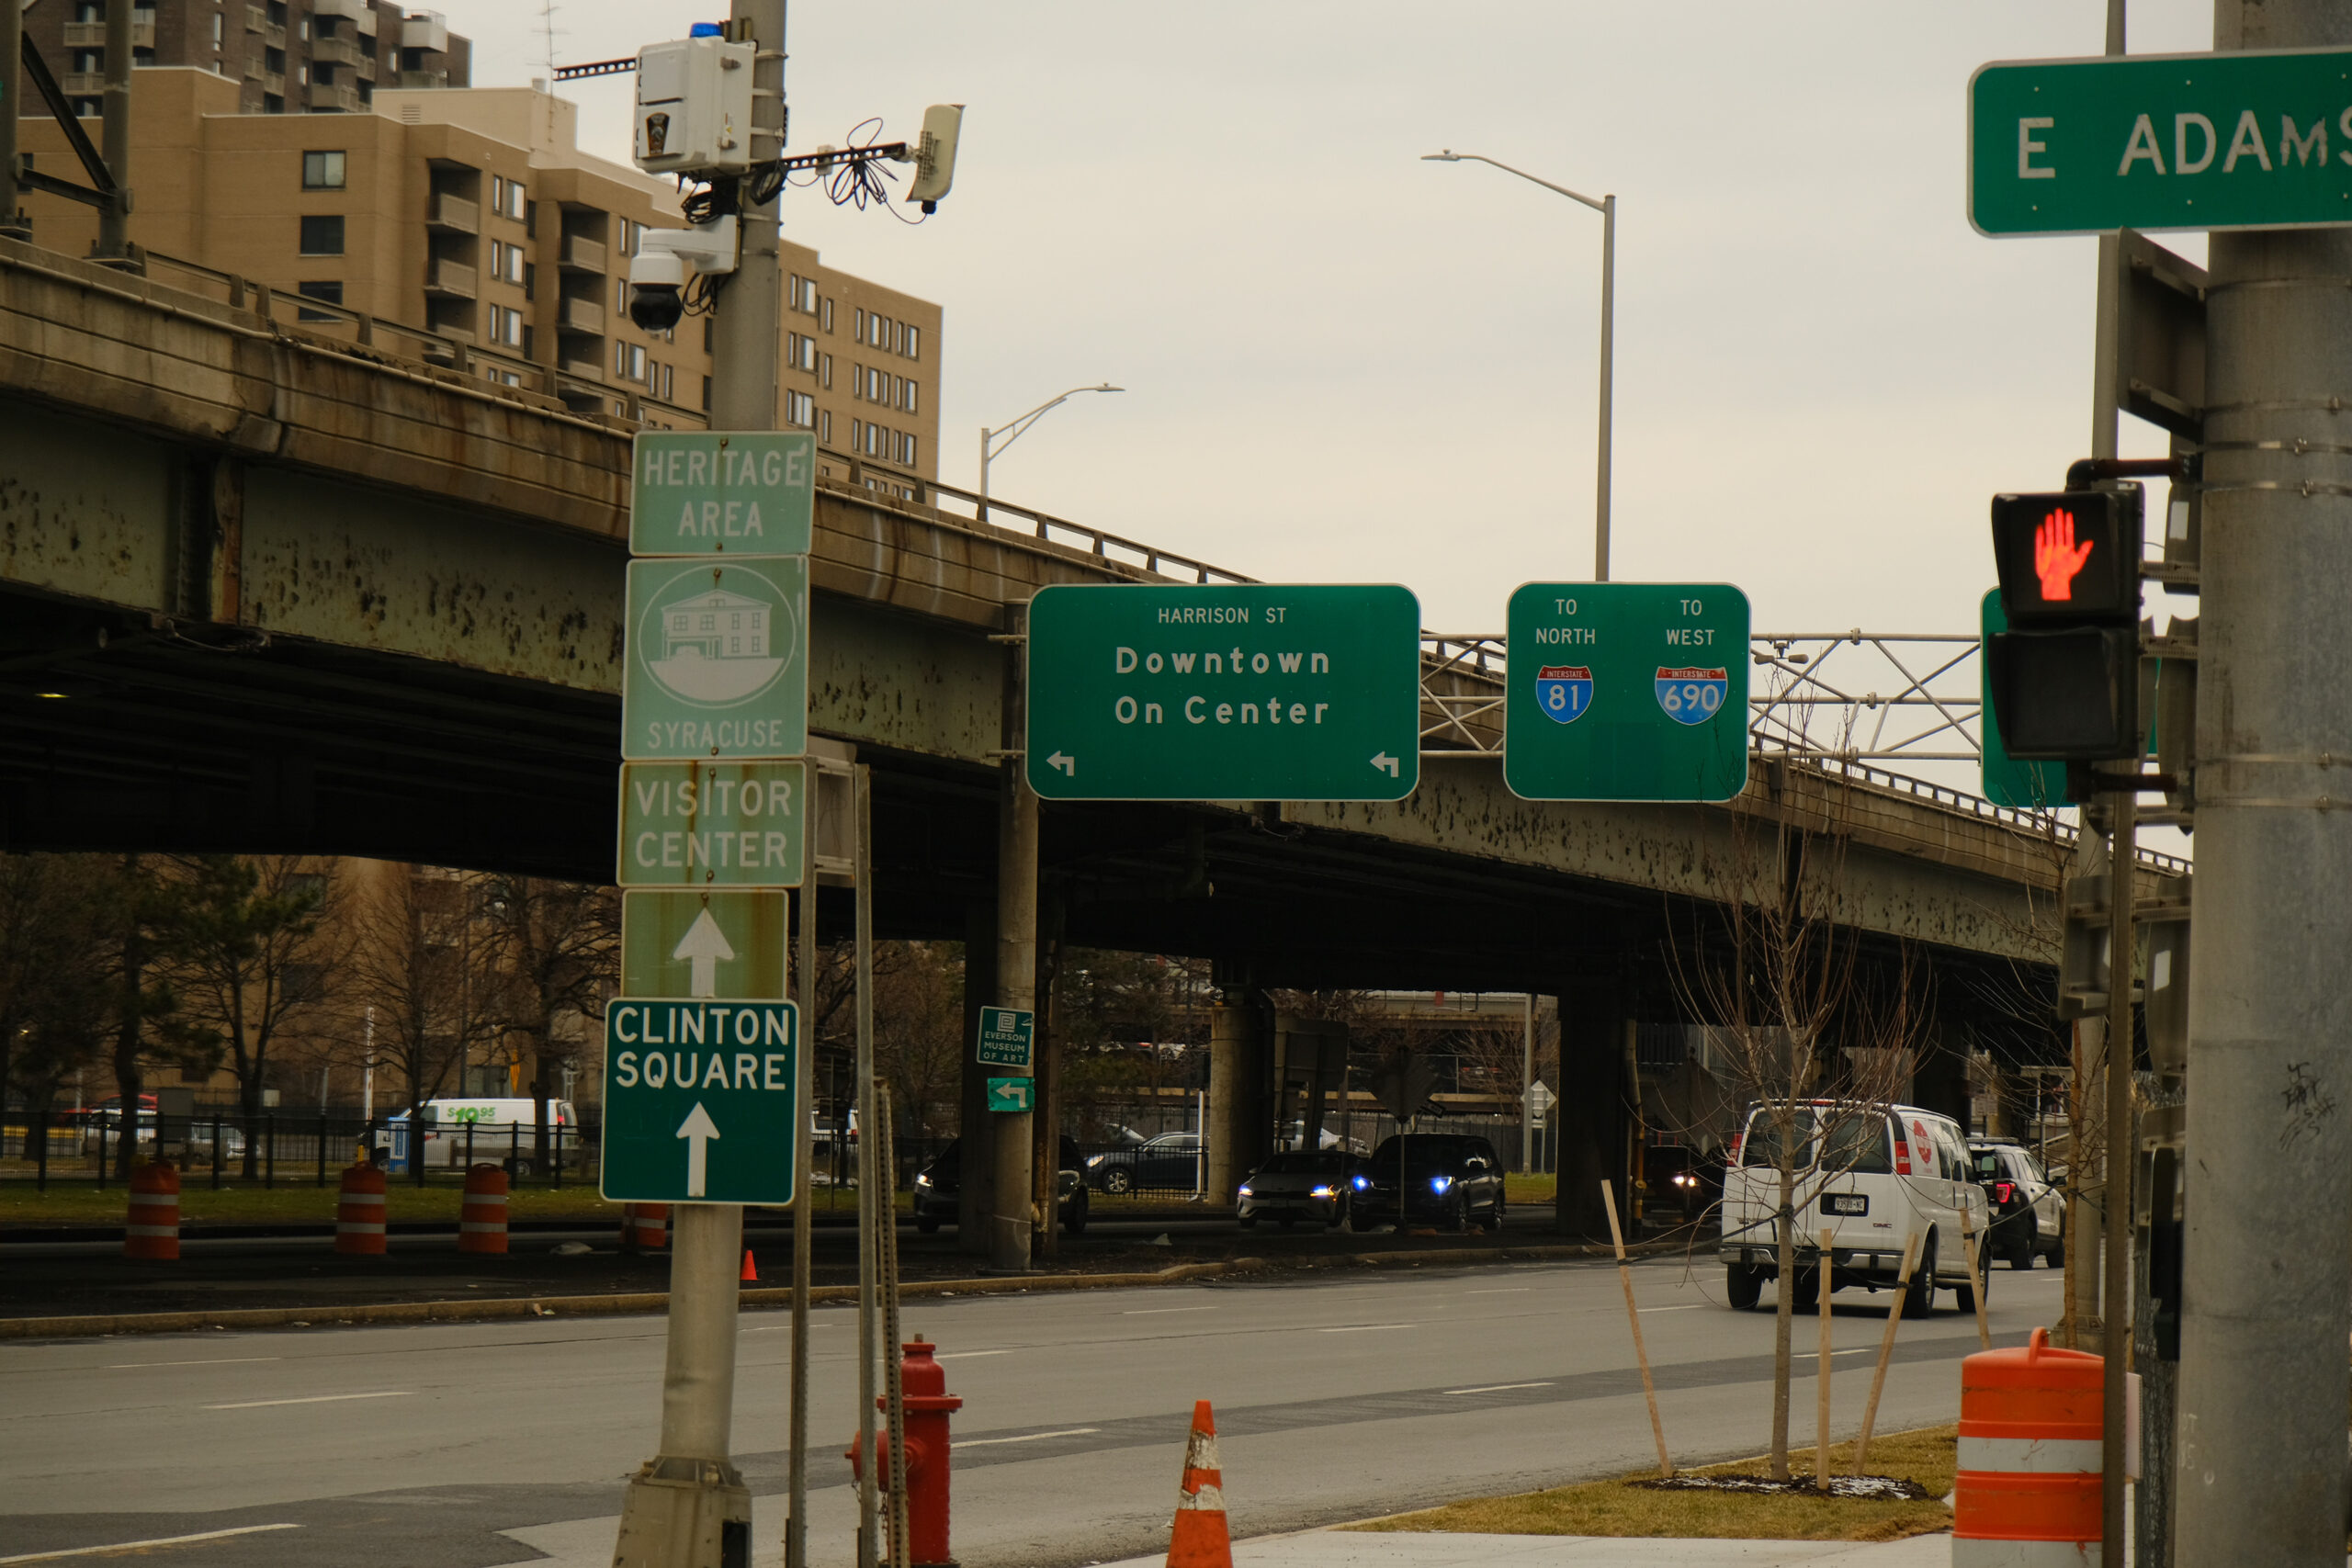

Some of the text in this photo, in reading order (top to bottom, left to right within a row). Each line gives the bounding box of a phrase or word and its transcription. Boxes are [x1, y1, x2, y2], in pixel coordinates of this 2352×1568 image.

[2018, 117, 2056, 179] E
[644, 449, 806, 487] HERITAGE
[677, 501, 763, 537] AREA
[1158, 607, 1286, 624] HARRISON ST
[1555, 598, 1577, 615] TO
[1679, 599, 1702, 616] TO
[1535, 627, 1596, 645] NORTH
[1666, 628, 1715, 646] WEST
[1115, 646, 1329, 674] Downtown
[1546, 670, 1583, 679] INTERSTATE
[1671, 670, 1712, 679] INTERSTATE
[1114, 695, 1329, 725] On Center
[1548, 684, 1578, 711] 81
[1664, 684, 1720, 711] 690
[647, 719, 783, 750] SYRACUSE
[635, 780, 791, 817] VISITOR
[635, 831, 787, 868] CENTER
[615, 1007, 789, 1046] CLINTON
[985, 1032, 1025, 1042] EVERSON
[984, 1042, 1024, 1052] MUSEUM
[1002, 1055, 1024, 1063] ART
[615, 1051, 786, 1090] SQUARE
